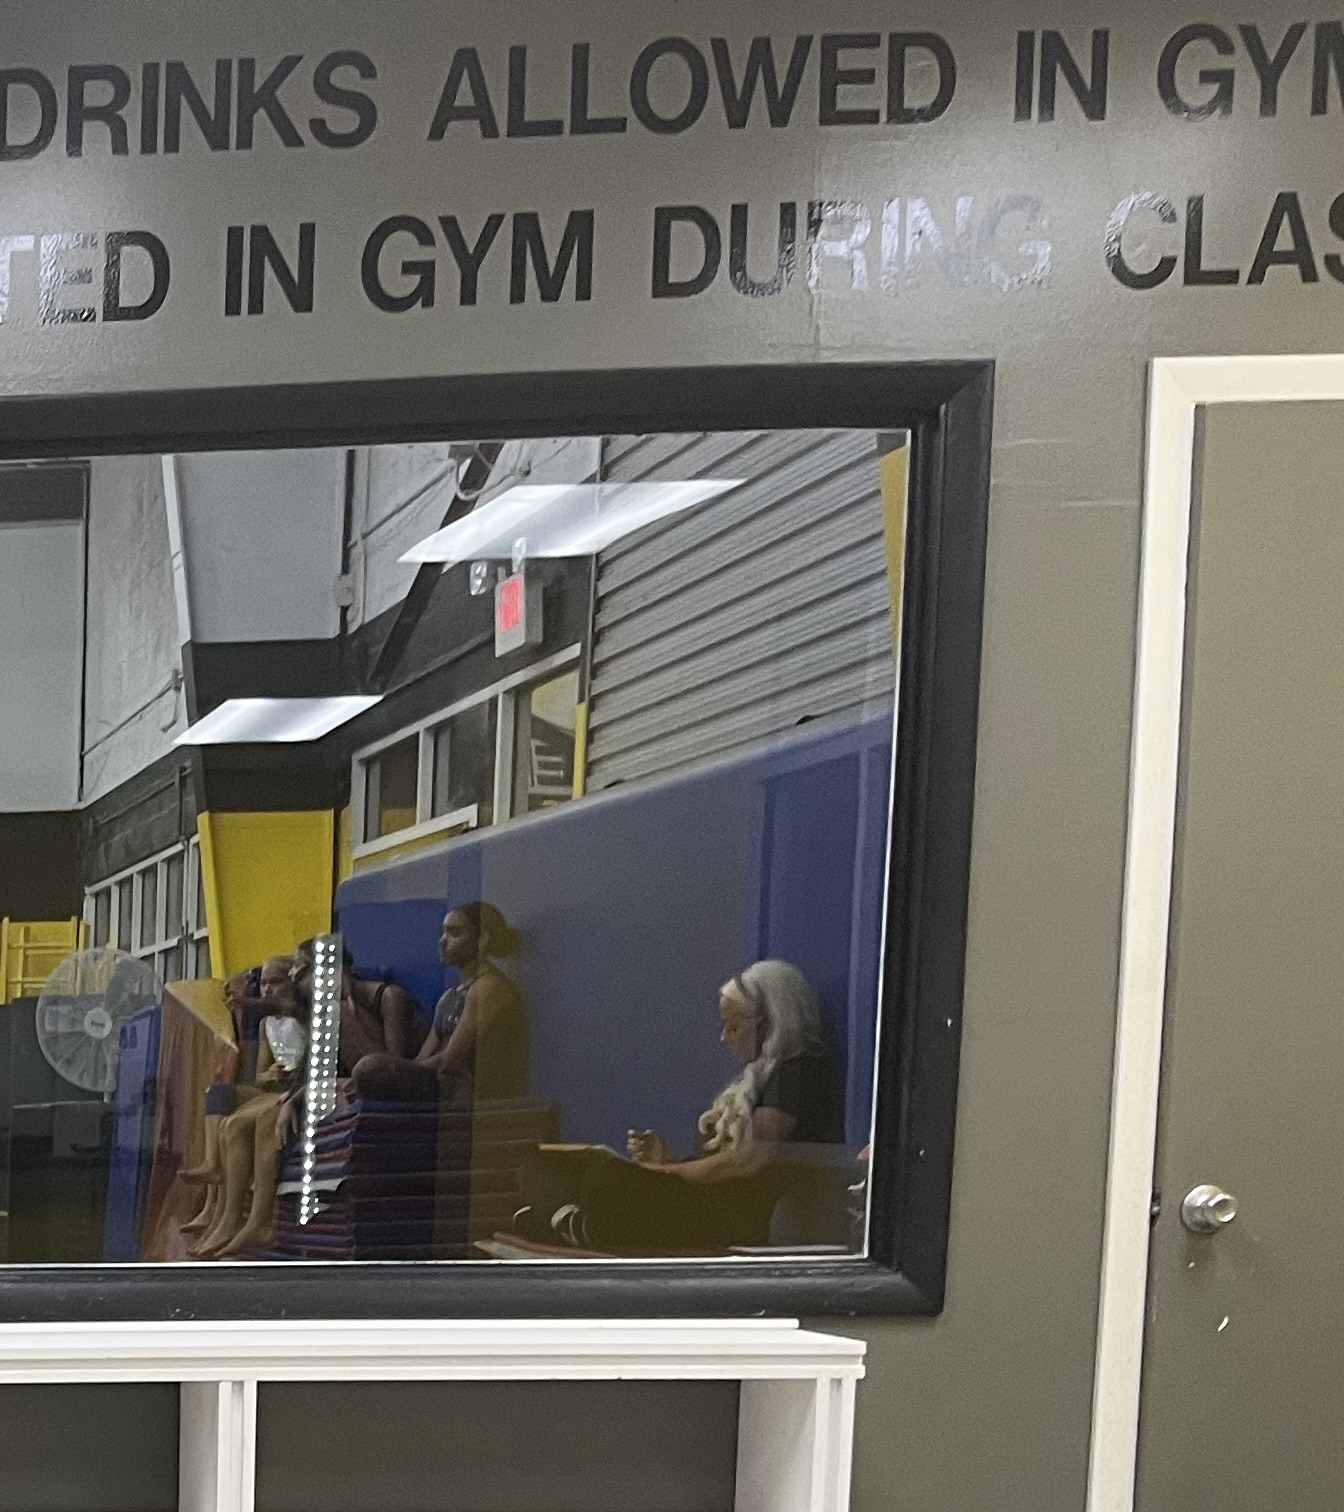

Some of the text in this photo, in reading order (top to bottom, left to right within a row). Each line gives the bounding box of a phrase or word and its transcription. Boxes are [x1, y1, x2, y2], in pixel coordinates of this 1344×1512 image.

[427, 29, 958, 143] ALLOWED
[1013, 28, 1110, 123] IN
[223, 221, 317, 317] IN
[359, 209, 594, 313] GYM
[651, 193, 1053, 299] DURING
